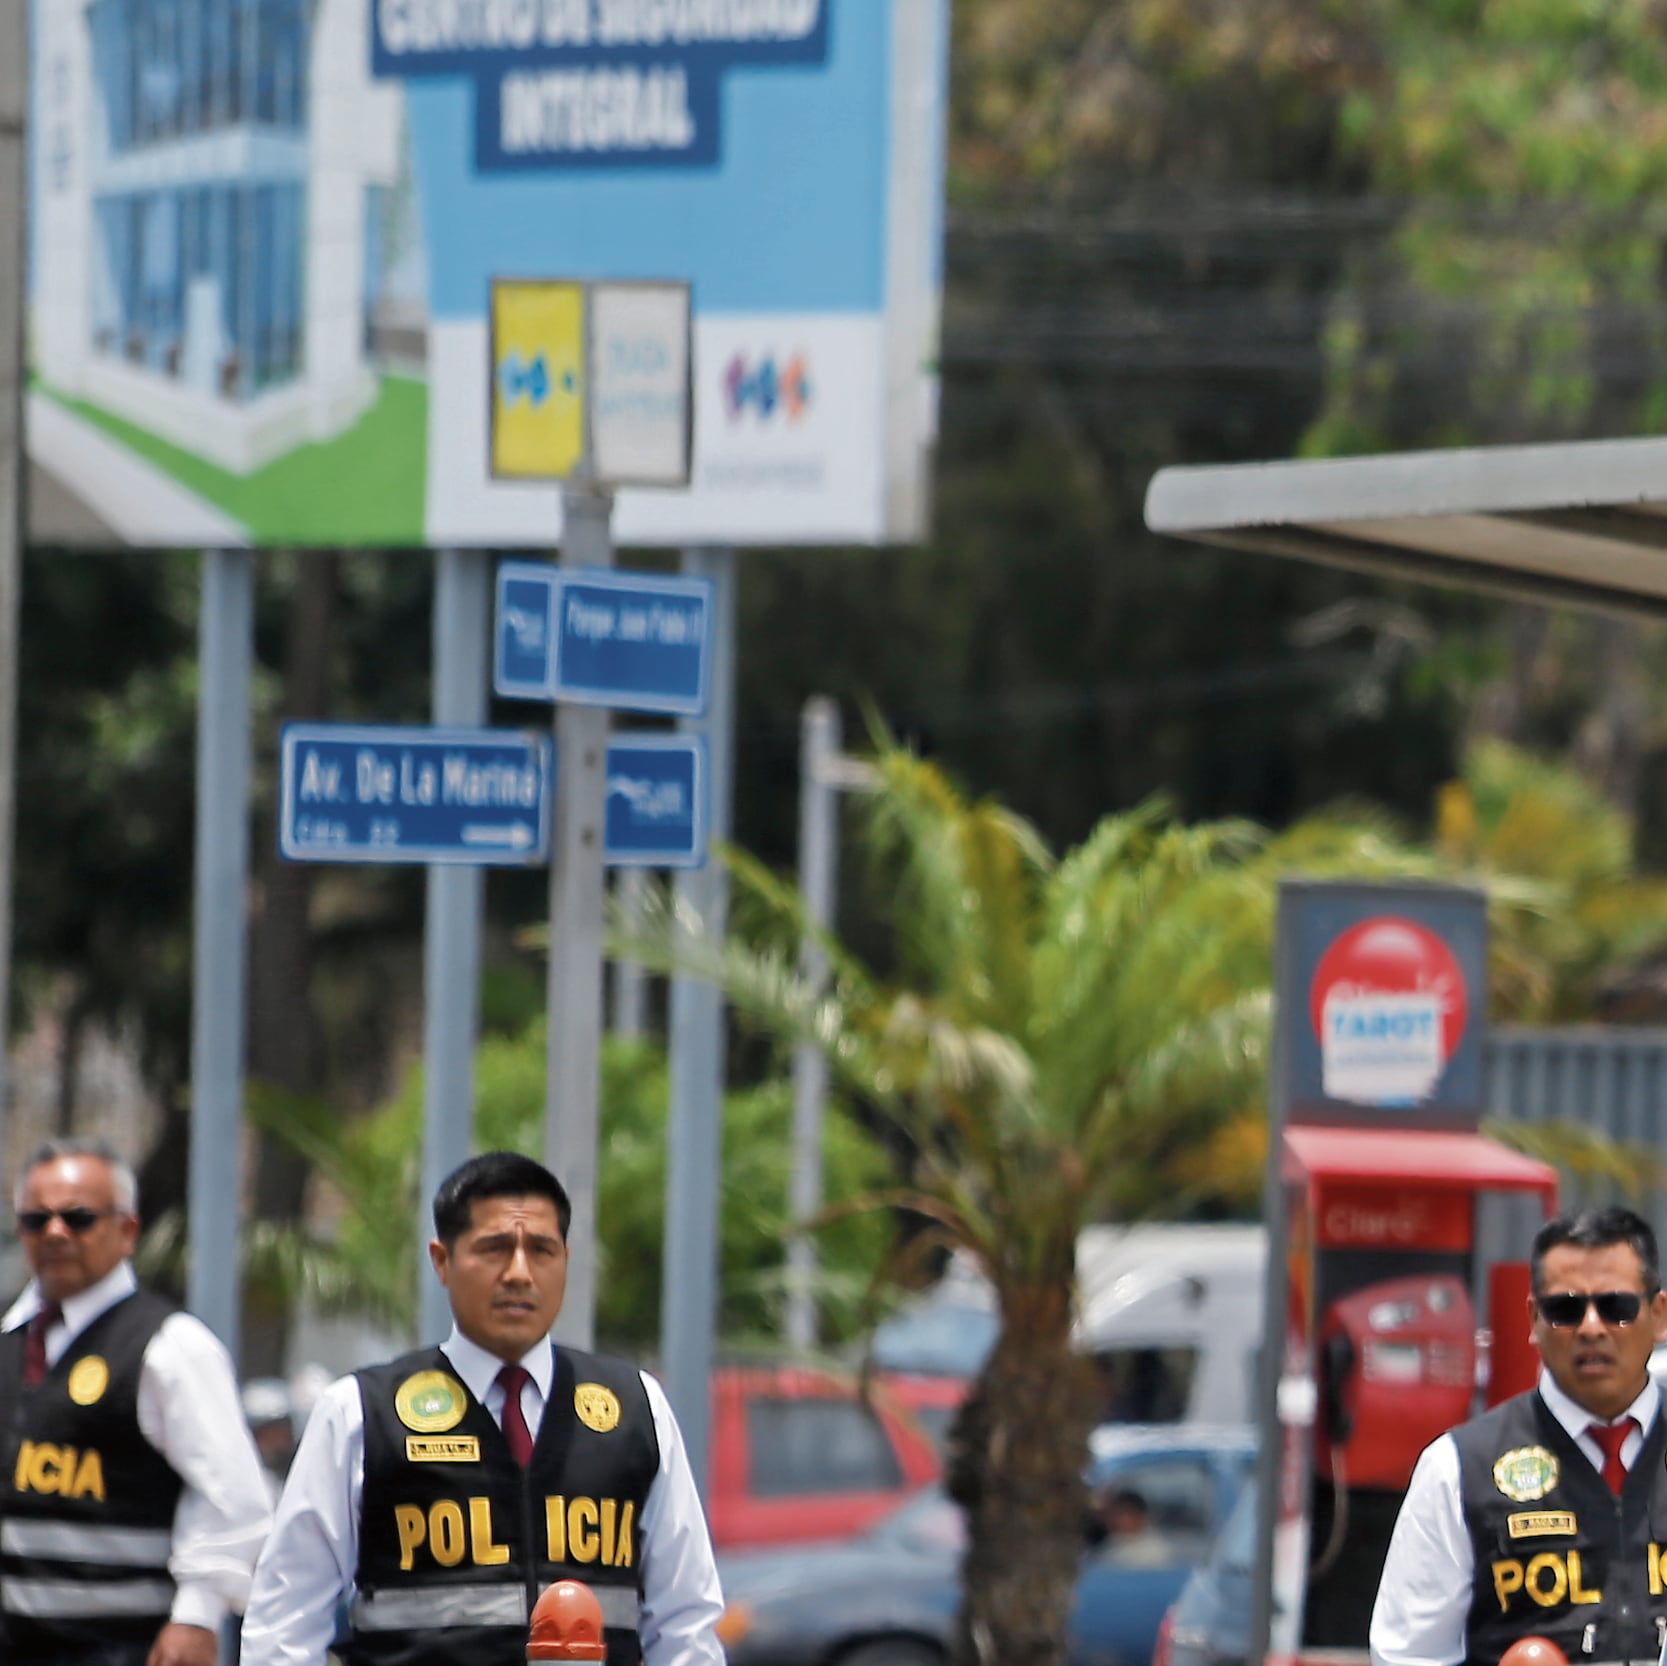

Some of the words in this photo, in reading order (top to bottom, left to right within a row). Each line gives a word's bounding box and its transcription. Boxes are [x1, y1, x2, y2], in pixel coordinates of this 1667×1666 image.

[501, 66, 695, 153] INTEGRAL
[301, 748, 345, 803] Av.
[356, 748, 396, 805] De
[400, 750, 437, 807] La
[442, 750, 537, 808] Marina
[15, 1438, 107, 1503] ICIA
[1492, 1549, 1602, 1614] POL
